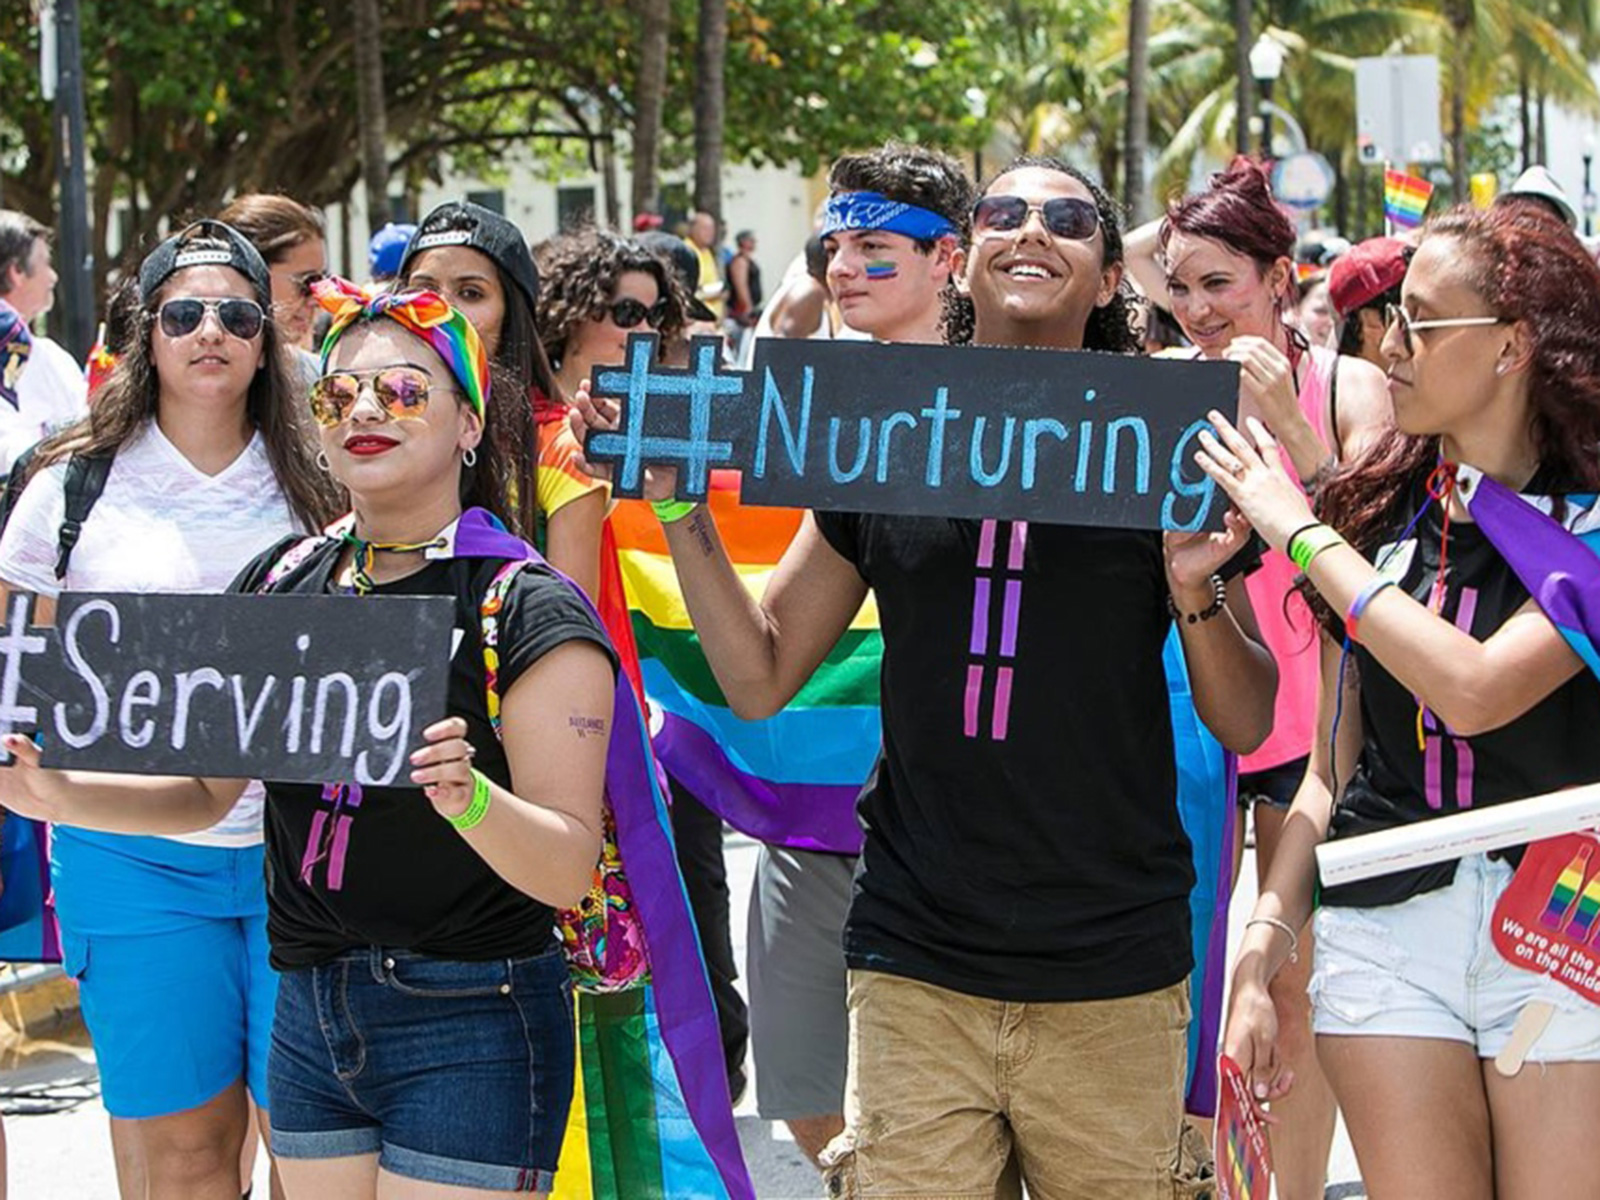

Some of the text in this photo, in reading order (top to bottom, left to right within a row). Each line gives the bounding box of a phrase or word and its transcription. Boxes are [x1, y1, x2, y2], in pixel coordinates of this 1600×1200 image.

[589, 340, 1219, 533] #Nurturing
[1502, 917, 1524, 939] We
[1525, 931, 1549, 950] are
[1549, 942, 1570, 960] all
[1570, 950, 1594, 972] the
[1515, 943, 1534, 961] on
[1535, 951, 1560, 972] the
